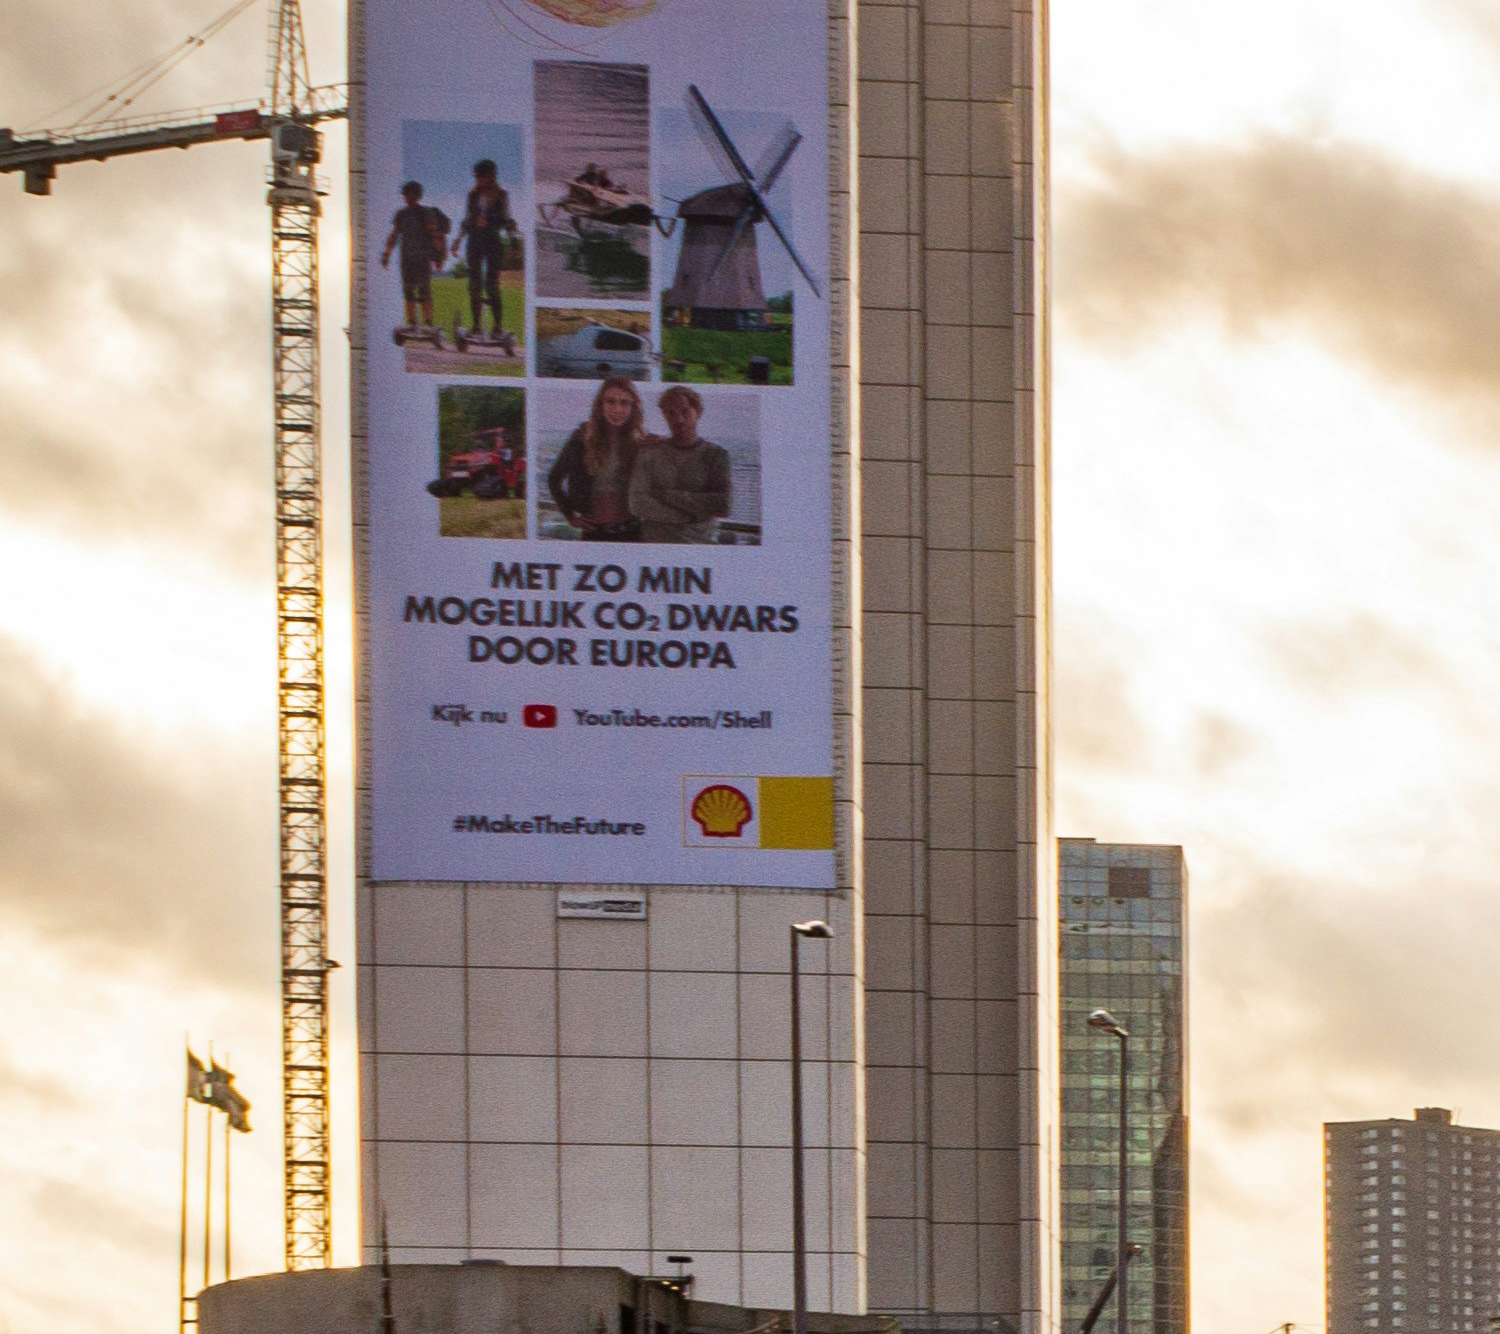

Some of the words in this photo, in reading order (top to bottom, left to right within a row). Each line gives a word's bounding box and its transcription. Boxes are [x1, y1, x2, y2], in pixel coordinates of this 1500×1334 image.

[490, 561, 563, 592] MET
[573, 564, 627, 593] ZO
[638, 565, 712, 595] MIN
[403, 595, 583, 630] MOGELIJK
[667, 604, 800, 634] DWARS
[468, 636, 579, 666] DOOR
[590, 639, 736, 669] EUROPA
[431, 703, 474, 727] Kijk
[480, 709, 508, 724] nu
[573, 707, 773, 731] YouTube.com/Shell
[452, 814, 646, 837] #MakeTheFuture
